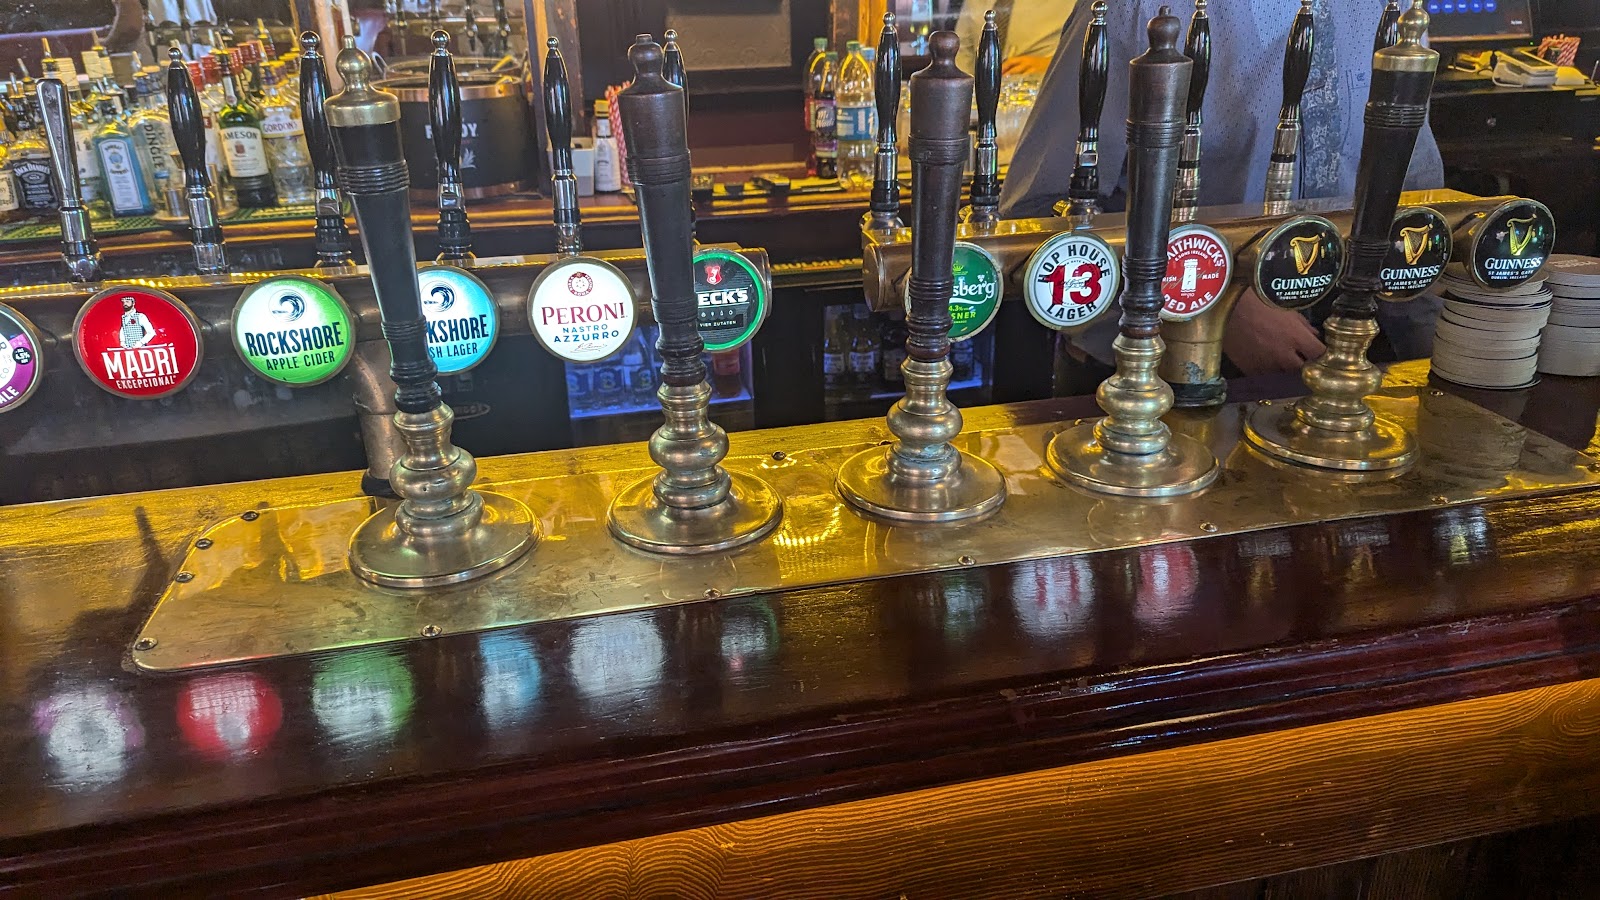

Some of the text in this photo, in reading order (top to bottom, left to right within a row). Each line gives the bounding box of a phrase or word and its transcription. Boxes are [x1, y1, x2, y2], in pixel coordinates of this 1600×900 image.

[224, 131, 258, 140] AMESON
[144, 124, 165, 169] DINGLE
[1037, 244, 1111, 284] HOP HOUSE
[1485, 257, 1543, 270] GUINNESS
[1201, 272, 1220, 280] MADE
[1380, 265, 1441, 280] GUINNESS
[953, 278, 996, 299] sberg
[1045, 262, 1102, 305] 13
[1271, 274, 1332, 290] GUINNESS
[697, 289, 748, 305] ECK'S
[1189, 291, 1214, 311] ALE
[541, 302, 625, 325] PERONI
[1046, 301, 1097, 320] LAGER
[427, 314, 490, 344] KSHORE
[553, 330, 620, 343] AZZURRO
[562, 323, 609, 334] NASTRO
[245, 322, 344, 357] ROCKSHORE
[447, 343, 478, 358] LAGER
[265, 350, 336, 371] APPLE CIDER
[116, 377, 175, 390] EXCEPCIONAL
